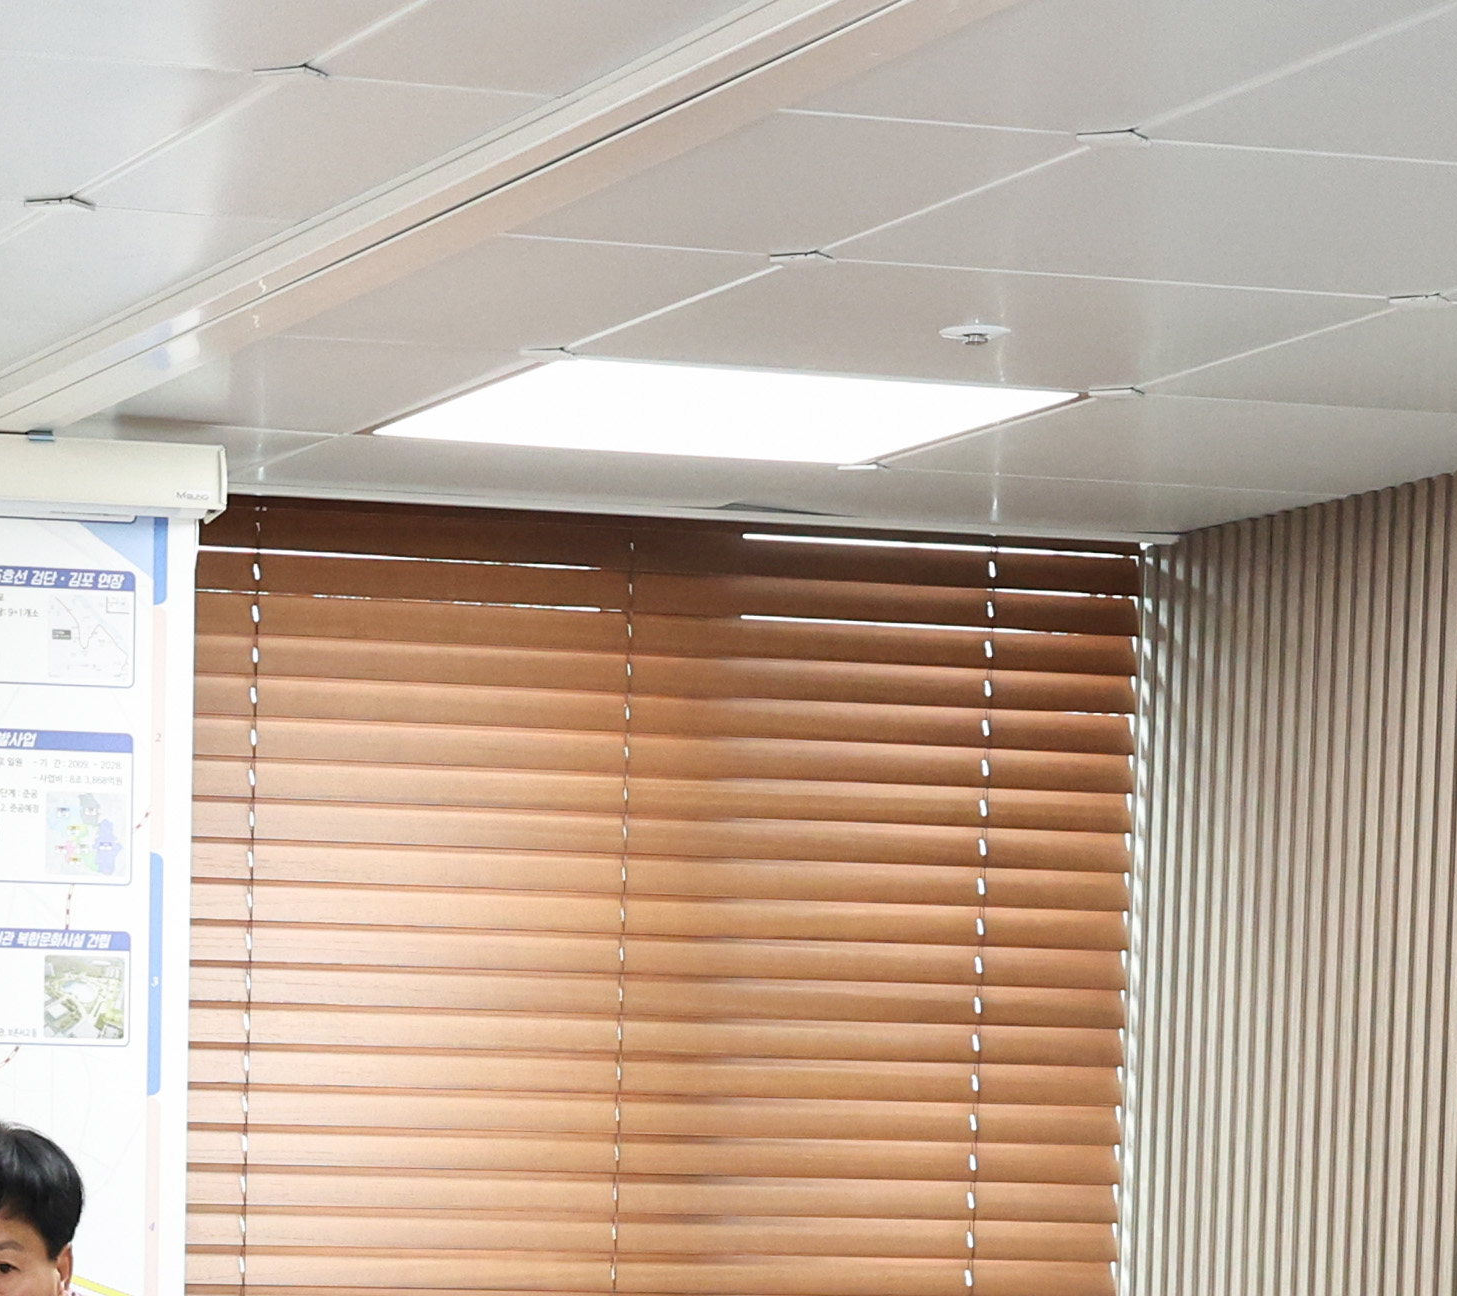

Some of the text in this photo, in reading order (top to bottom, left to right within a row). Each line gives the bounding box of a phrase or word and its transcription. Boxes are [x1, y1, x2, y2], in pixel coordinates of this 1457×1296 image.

[31, 569, 59, 588] 검단
[68, 571, 97, 588] 김포
[97, 573, 125, 589] 연장
[17, 930, 86, 949] 복합문화시설
[87, 932, 112, 949] 건립
